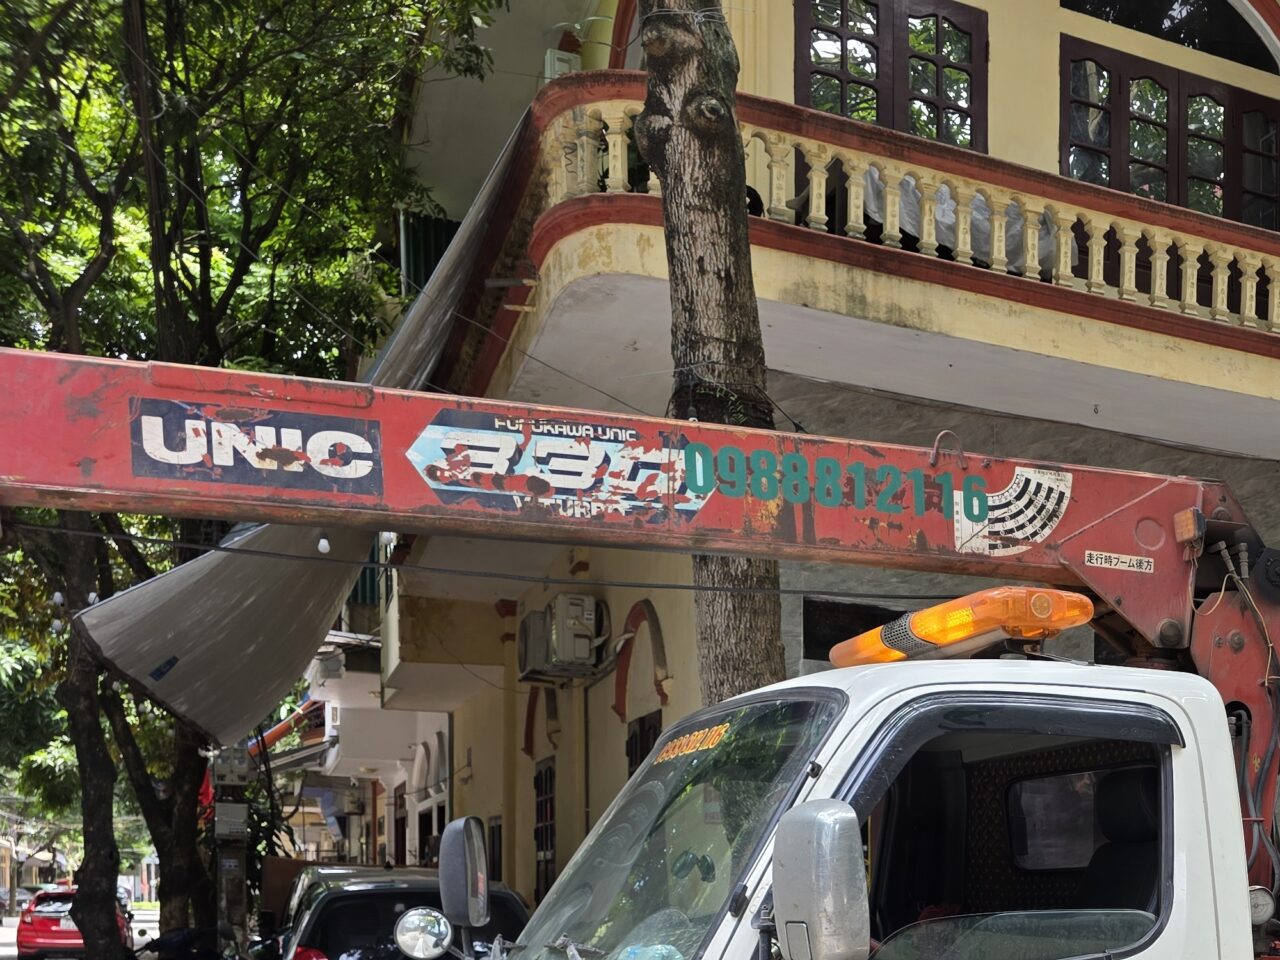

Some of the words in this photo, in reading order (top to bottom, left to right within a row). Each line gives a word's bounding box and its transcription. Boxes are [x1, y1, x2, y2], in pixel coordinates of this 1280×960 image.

[141, 415, 374, 479] UNIC
[597, 426, 637, 442] UNIC
[684, 442, 989, 524] 0988812116
[1086, 552, 1153, 571] 走行時ブーム後方
